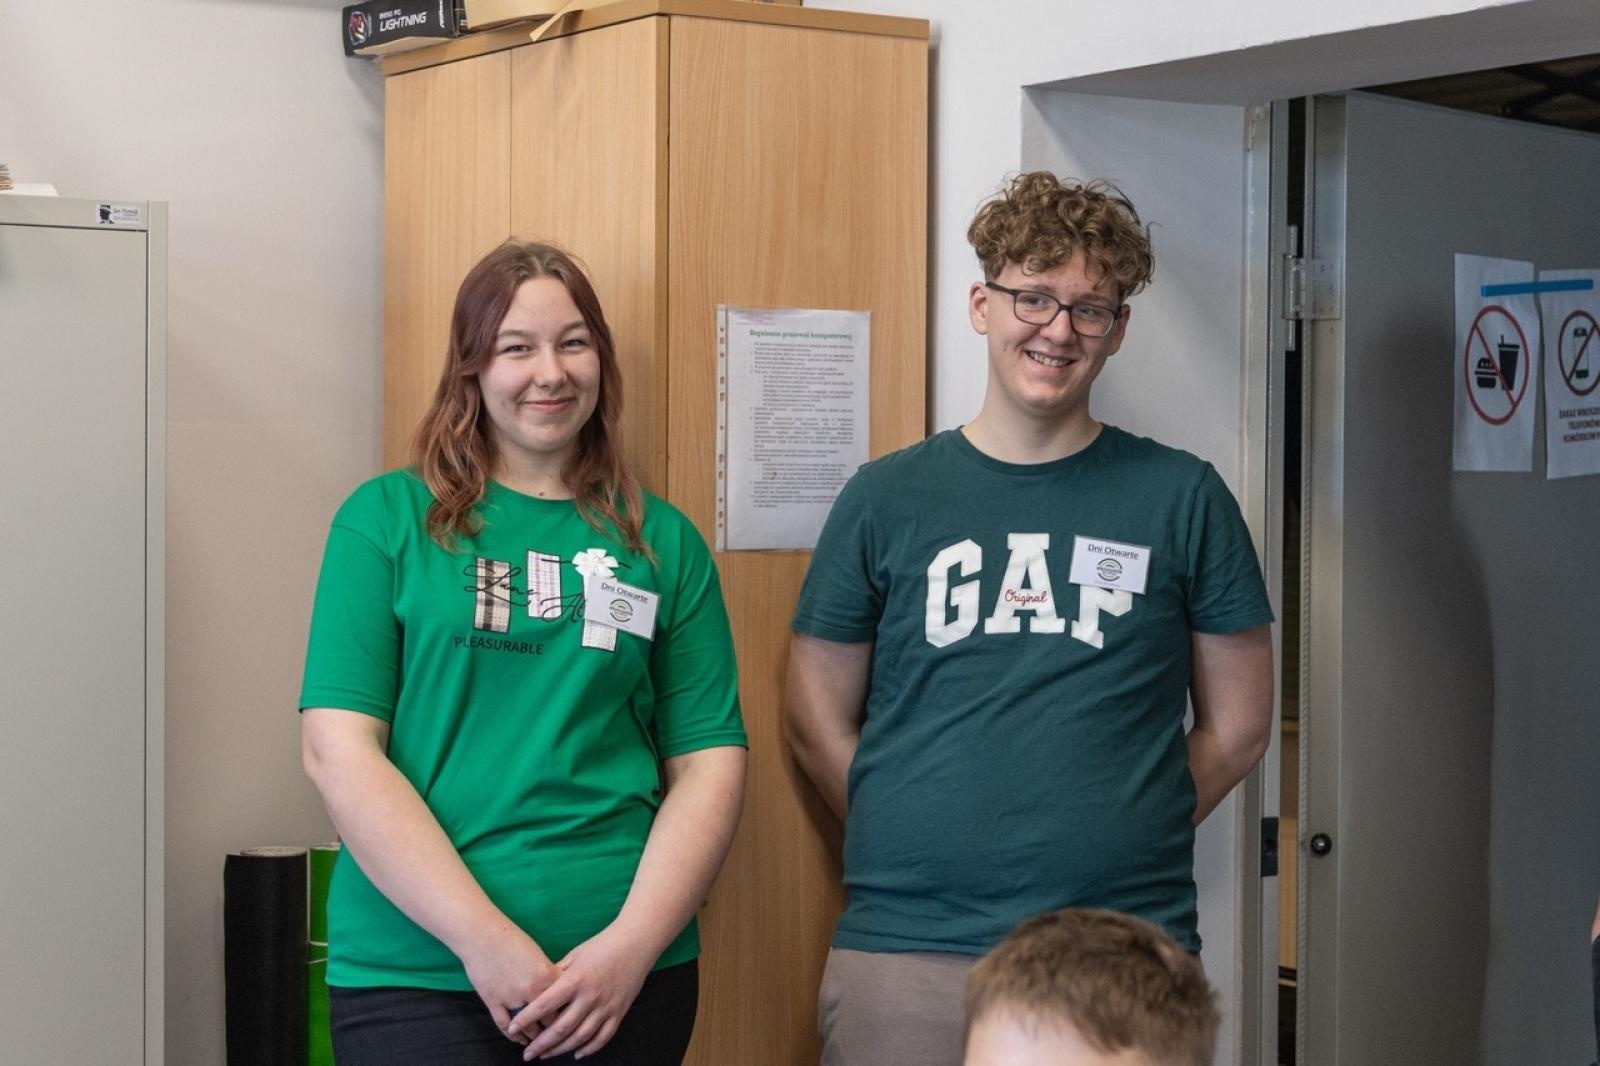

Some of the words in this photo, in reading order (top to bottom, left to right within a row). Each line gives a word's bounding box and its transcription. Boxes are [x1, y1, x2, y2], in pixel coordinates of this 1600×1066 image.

[379, 12, 427, 32] LIGHTNING
[1087, 543, 1102, 552] Dni
[1104, 547, 1139, 560] Otwarte
[600, 582, 616, 592] Dni
[617, 587, 649, 604] Otwarte
[1004, 589, 1048, 607] Original
[454, 636, 544, 656] PLEASURABLE
